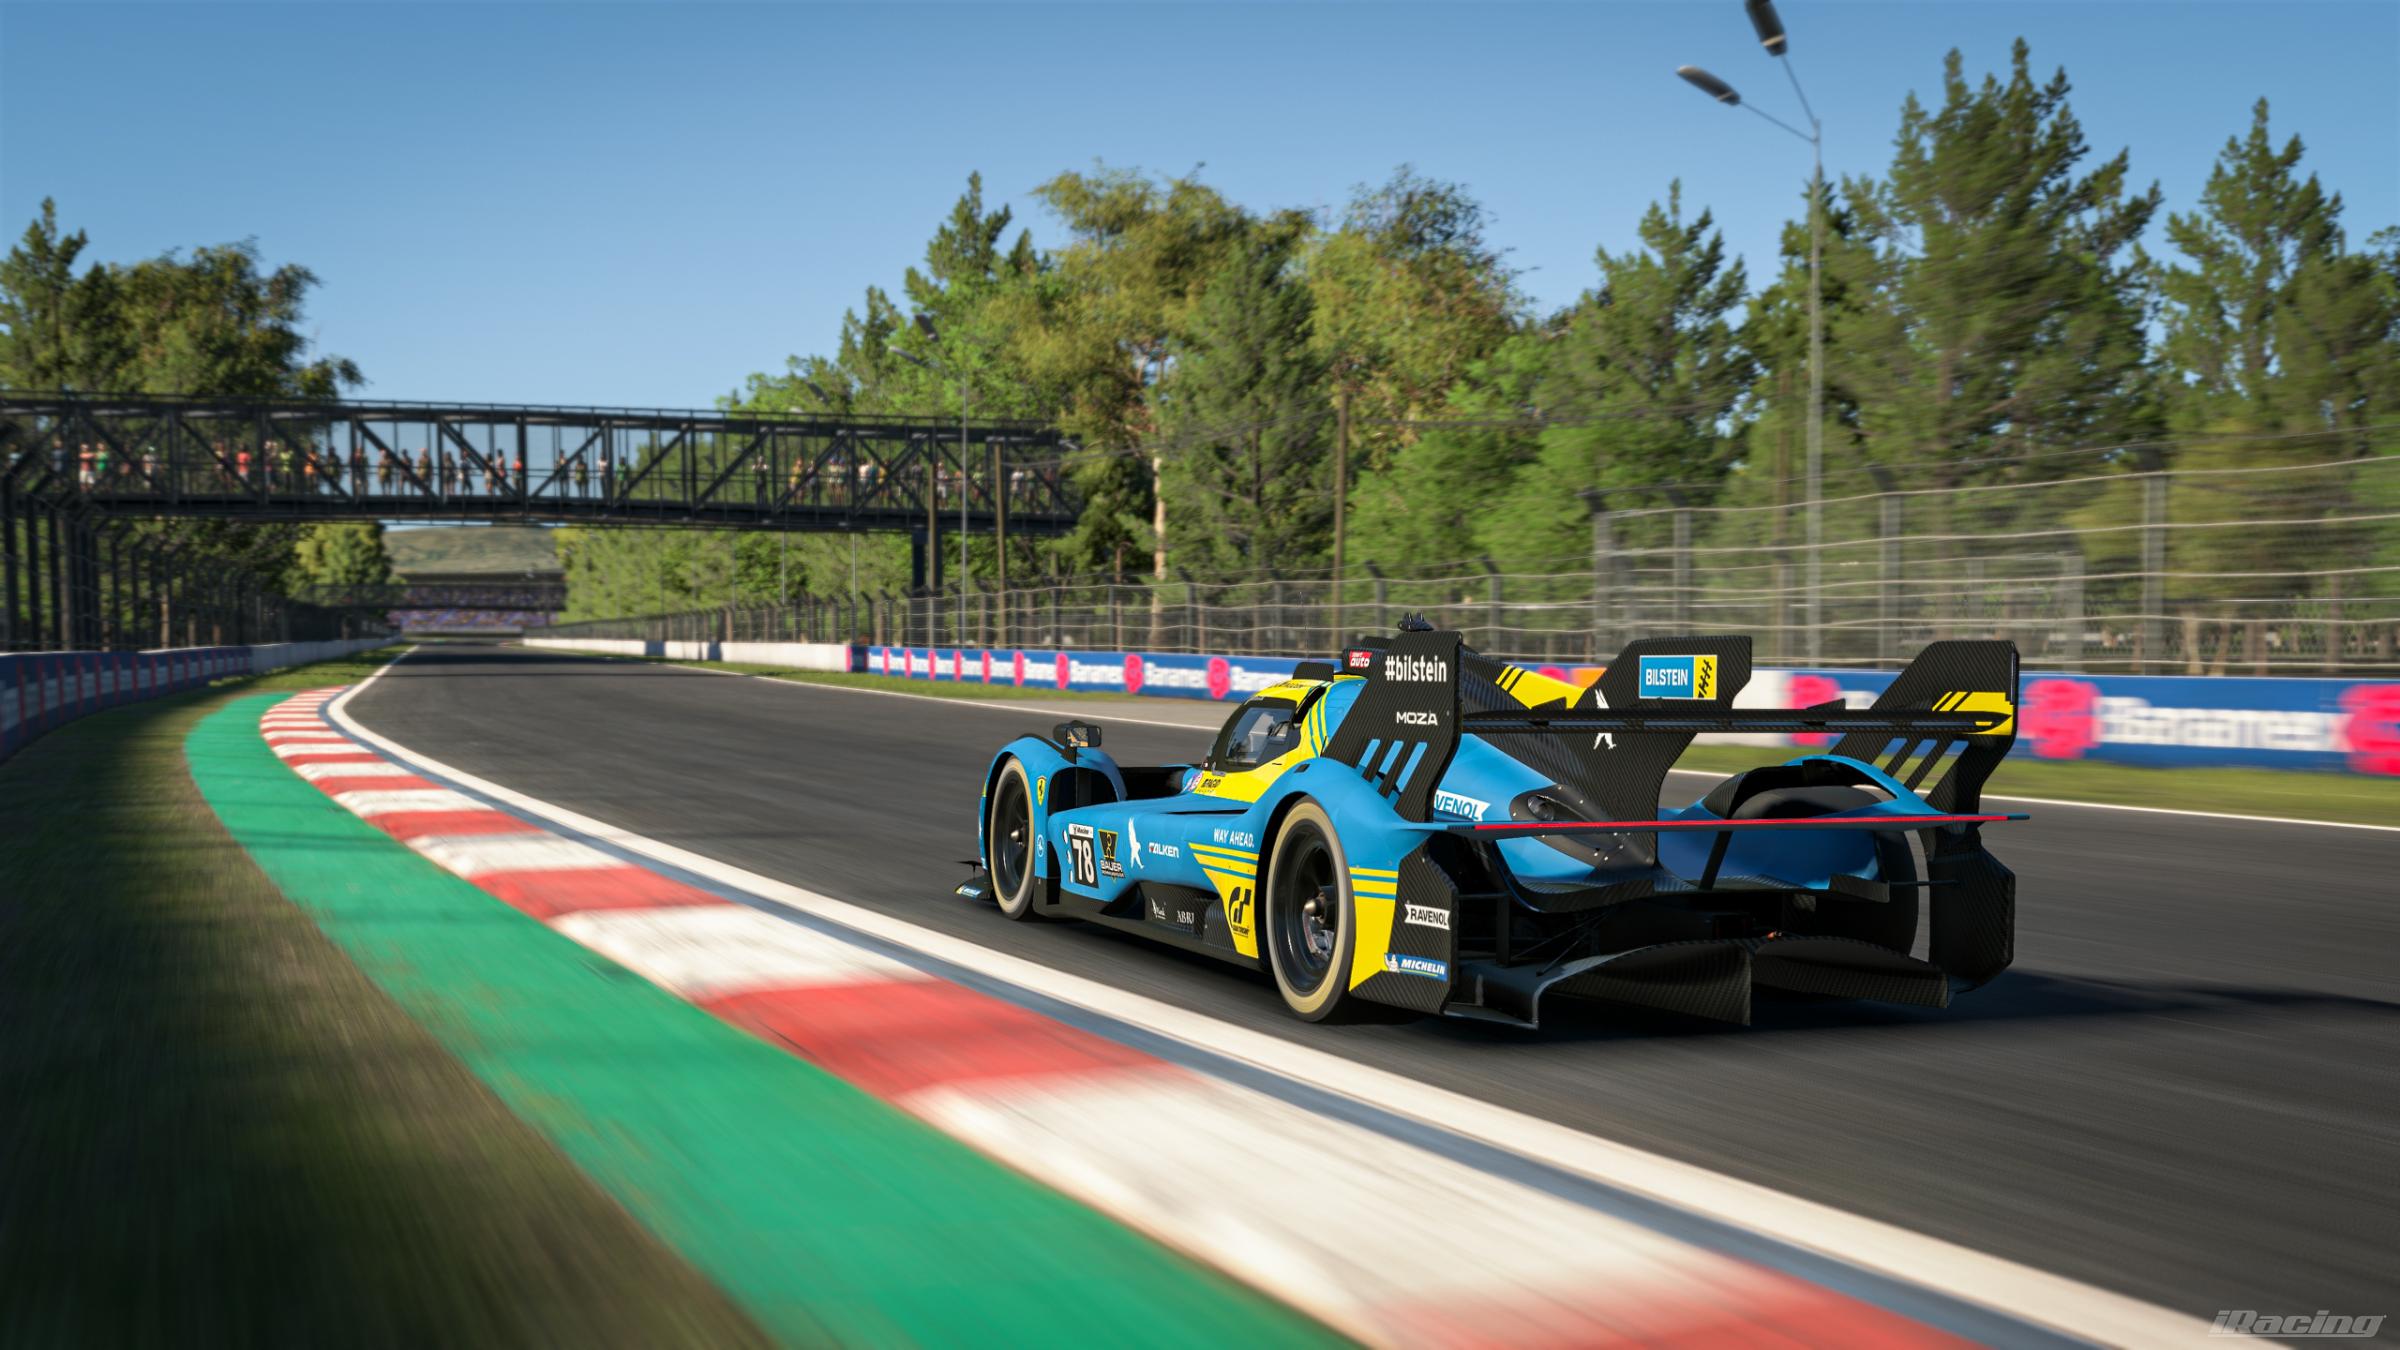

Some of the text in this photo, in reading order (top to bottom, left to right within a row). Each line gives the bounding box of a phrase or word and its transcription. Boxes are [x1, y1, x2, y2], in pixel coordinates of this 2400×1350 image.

[1350, 657, 1370, 668] auto
[1385, 654, 1447, 682] #bilstein
[1645, 668, 1688, 686] BILSTEIN
[1396, 712, 1438, 726] MOZA
[1435, 794, 1479, 820] VENOL
[1214, 828, 1255, 848] WAY AHEAD.
[1072, 838, 1095, 884] 78
[1100, 859, 1124, 872] BAUER
[1410, 908, 1447, 926] RAVENOL
[1401, 959, 1446, 975] MICHELIN
